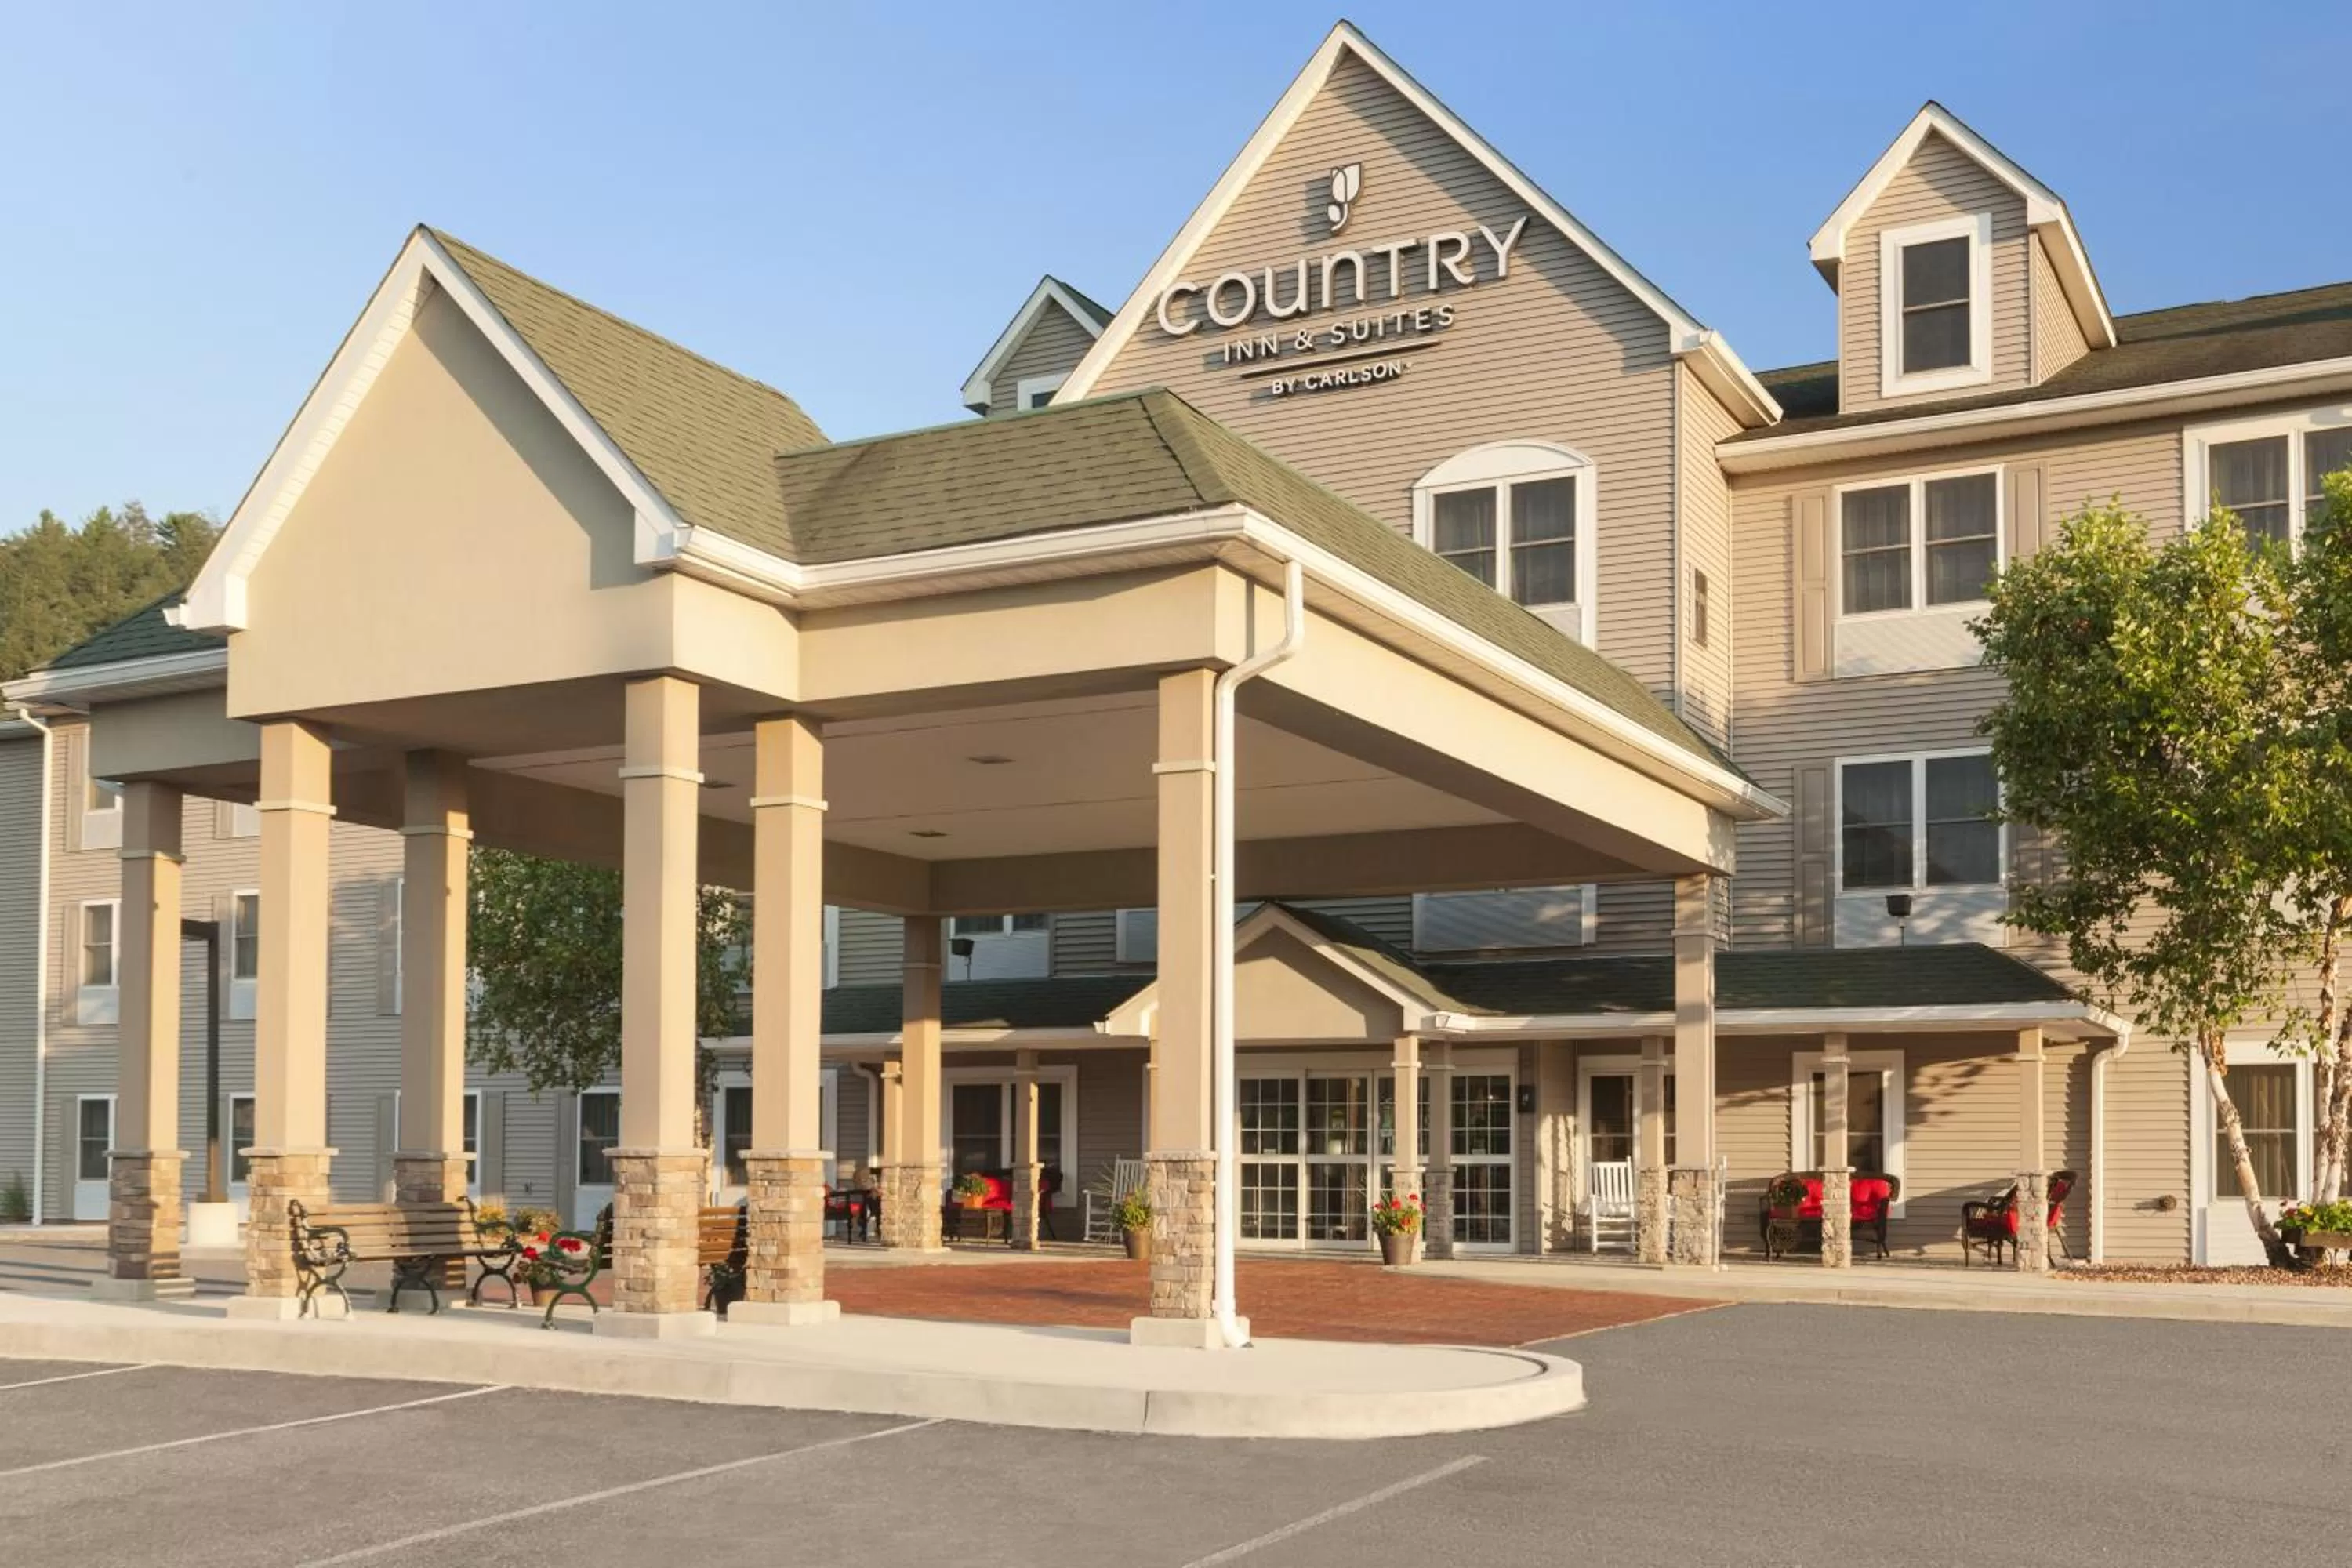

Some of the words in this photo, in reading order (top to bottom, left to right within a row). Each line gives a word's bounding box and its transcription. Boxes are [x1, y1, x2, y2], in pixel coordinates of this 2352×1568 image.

[1156, 216, 1531, 336] COUNTRY
[1223, 333, 1279, 364] INN
[1294, 328, 1314, 351] &
[1329, 304, 1455, 345] SUITES
[1272, 376, 1296, 395] BY
[1304, 359, 1402, 390] CARLSON
